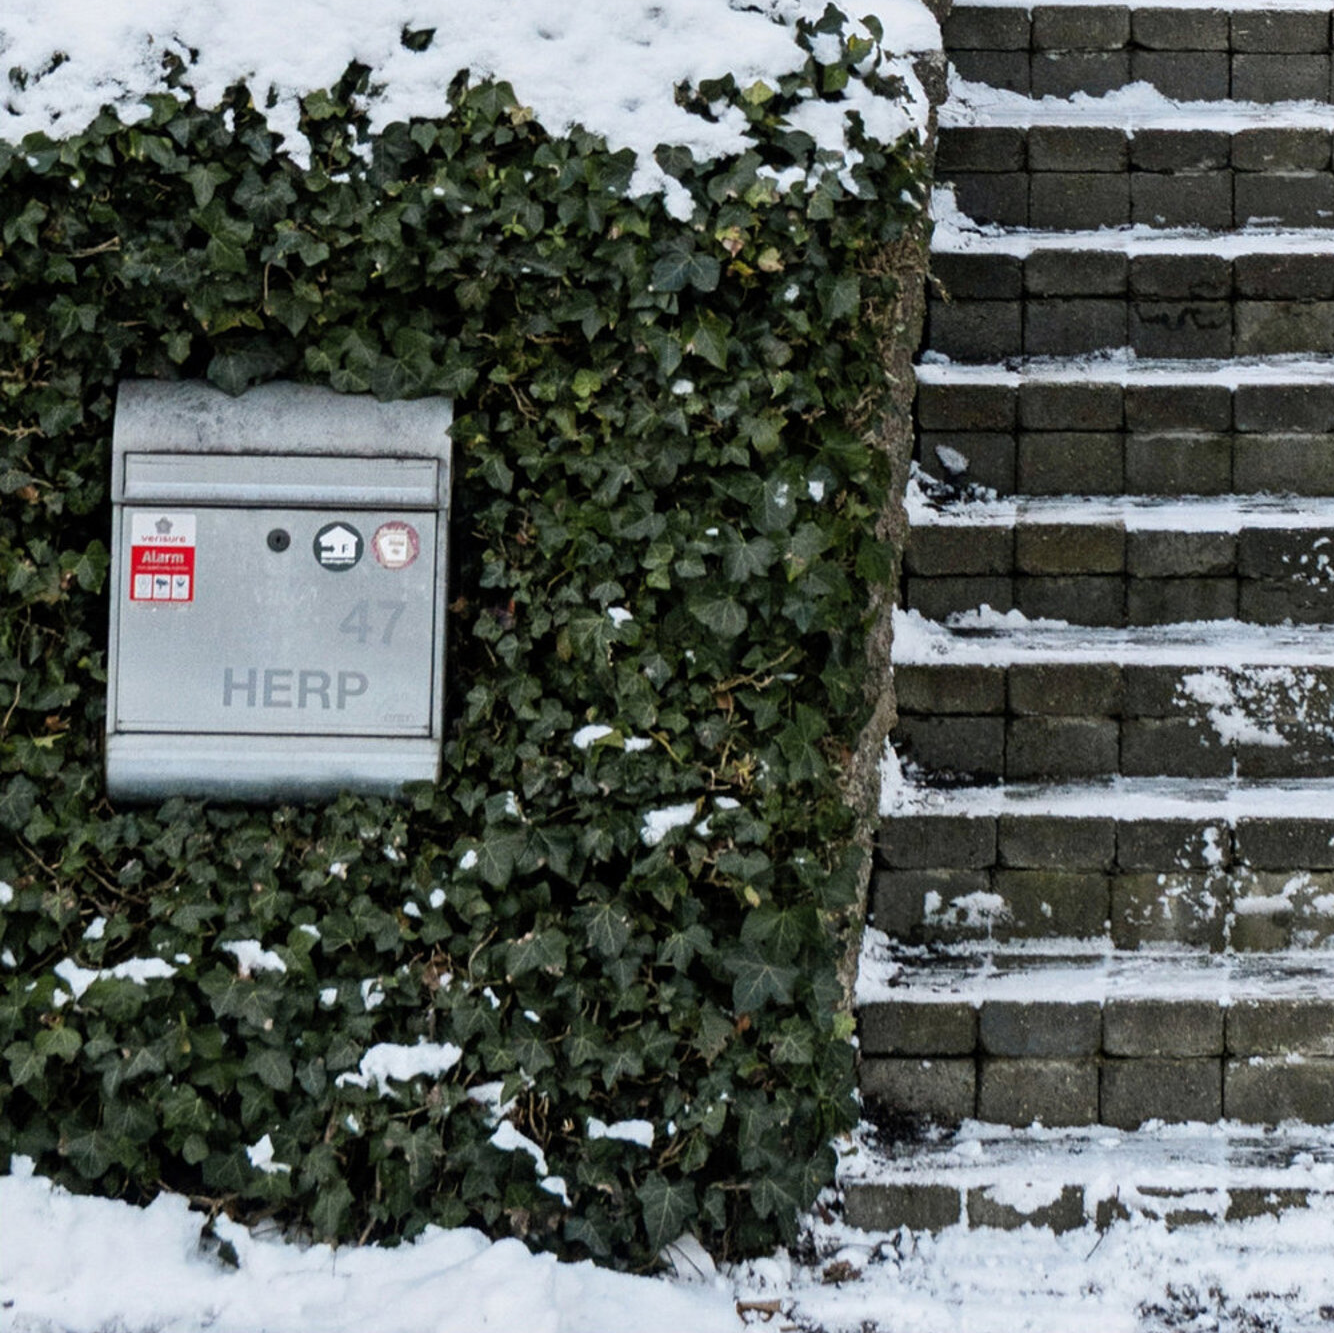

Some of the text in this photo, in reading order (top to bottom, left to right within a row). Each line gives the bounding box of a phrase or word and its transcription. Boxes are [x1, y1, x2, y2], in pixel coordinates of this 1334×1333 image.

[141, 549, 185, 564] Alarm
[339, 598, 407, 646] 47
[222, 666, 370, 710] HERP
